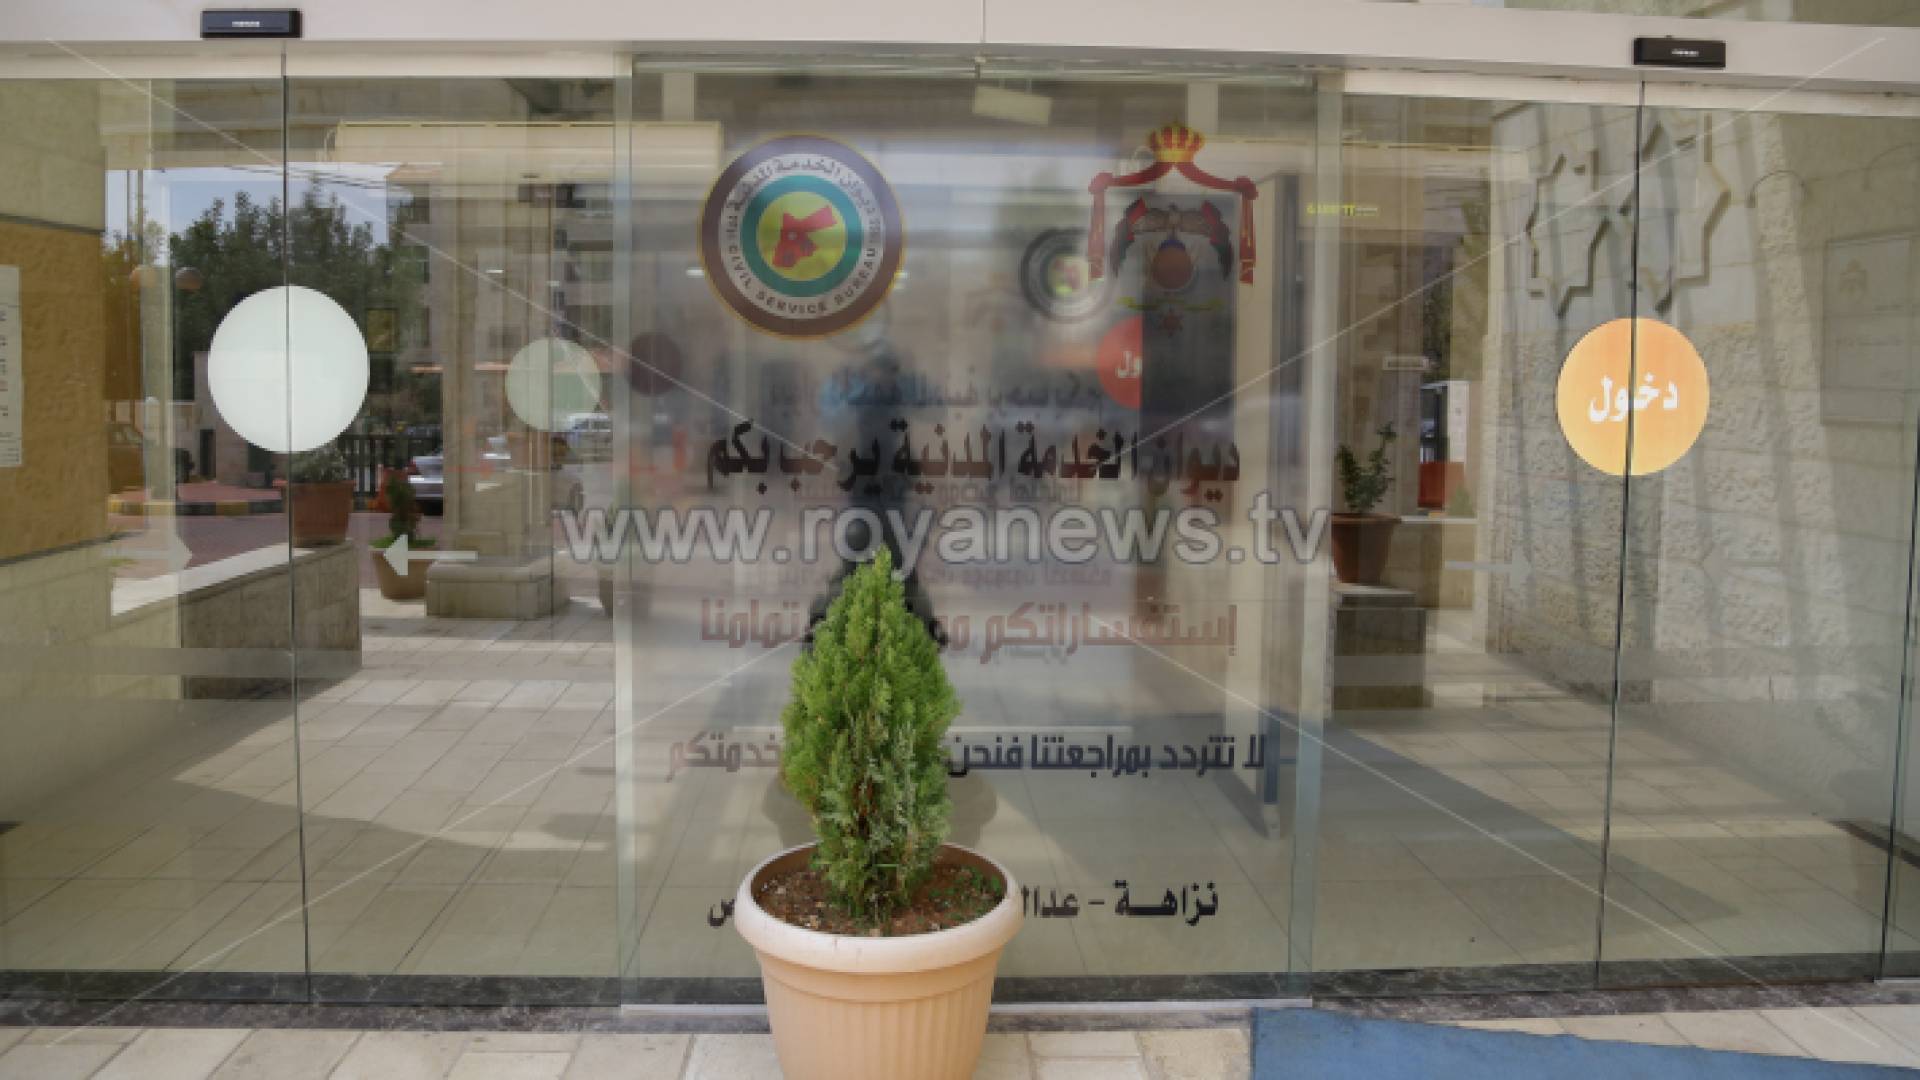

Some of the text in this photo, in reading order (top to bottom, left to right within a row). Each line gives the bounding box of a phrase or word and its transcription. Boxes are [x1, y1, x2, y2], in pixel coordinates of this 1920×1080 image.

[727, 245, 876, 314] CIVIL SERVICE BUREAU
[1588, 371, 1680, 423] دخول
[707, 417, 1240, 502] ديوان الخدمة المدنية يرحب بكم
[948, 736, 1023, 778] فنحن
[1032, 734, 1151, 778] بمراجعتنا
[1160, 735, 1235, 778] تتردد
[1243, 734, 1265, 770] لا
